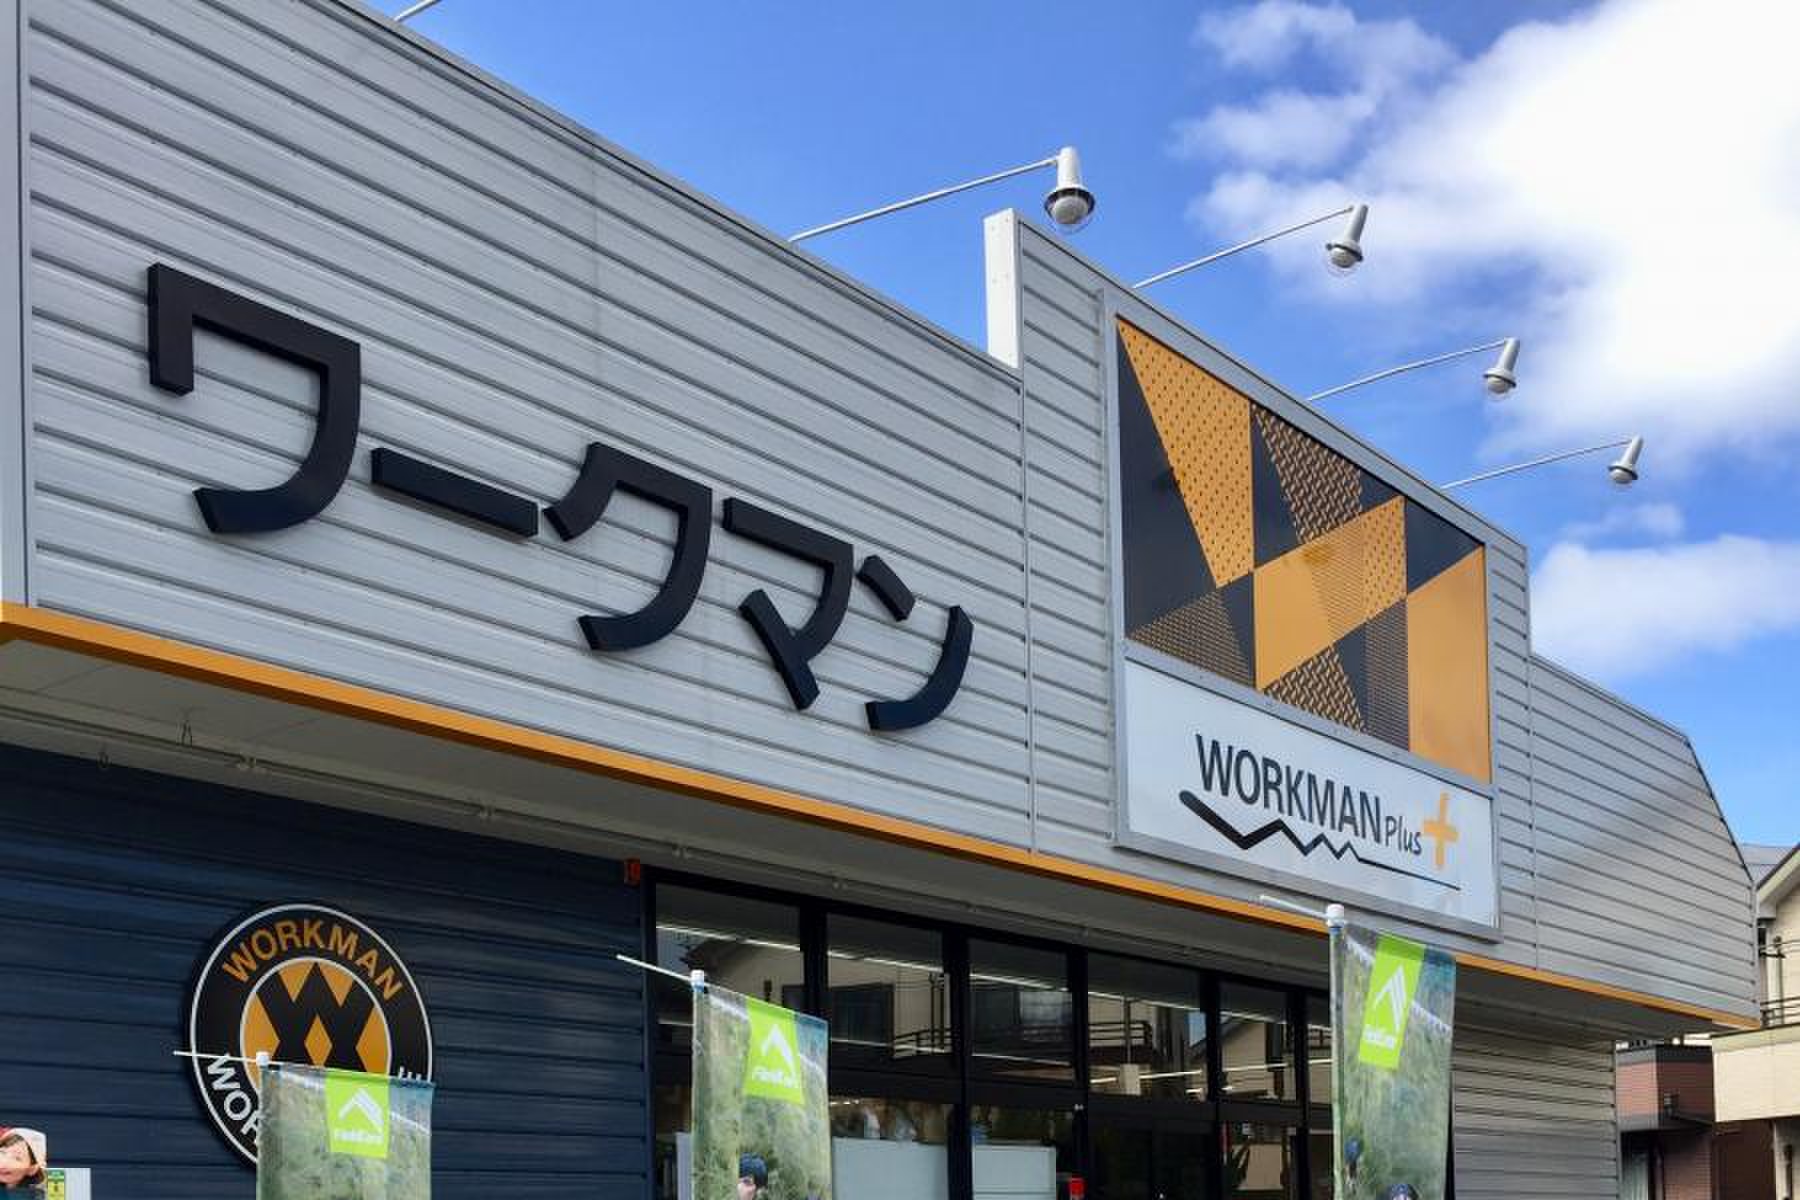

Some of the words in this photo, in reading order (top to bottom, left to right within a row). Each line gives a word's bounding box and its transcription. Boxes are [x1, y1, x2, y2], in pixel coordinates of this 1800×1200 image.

[147, 261, 974, 731] ワークマン
[1195, 733, 1382, 846] WORKMAN
[1385, 815, 1422, 856] Plus
[223, 918, 403, 1001] WORKMAN
